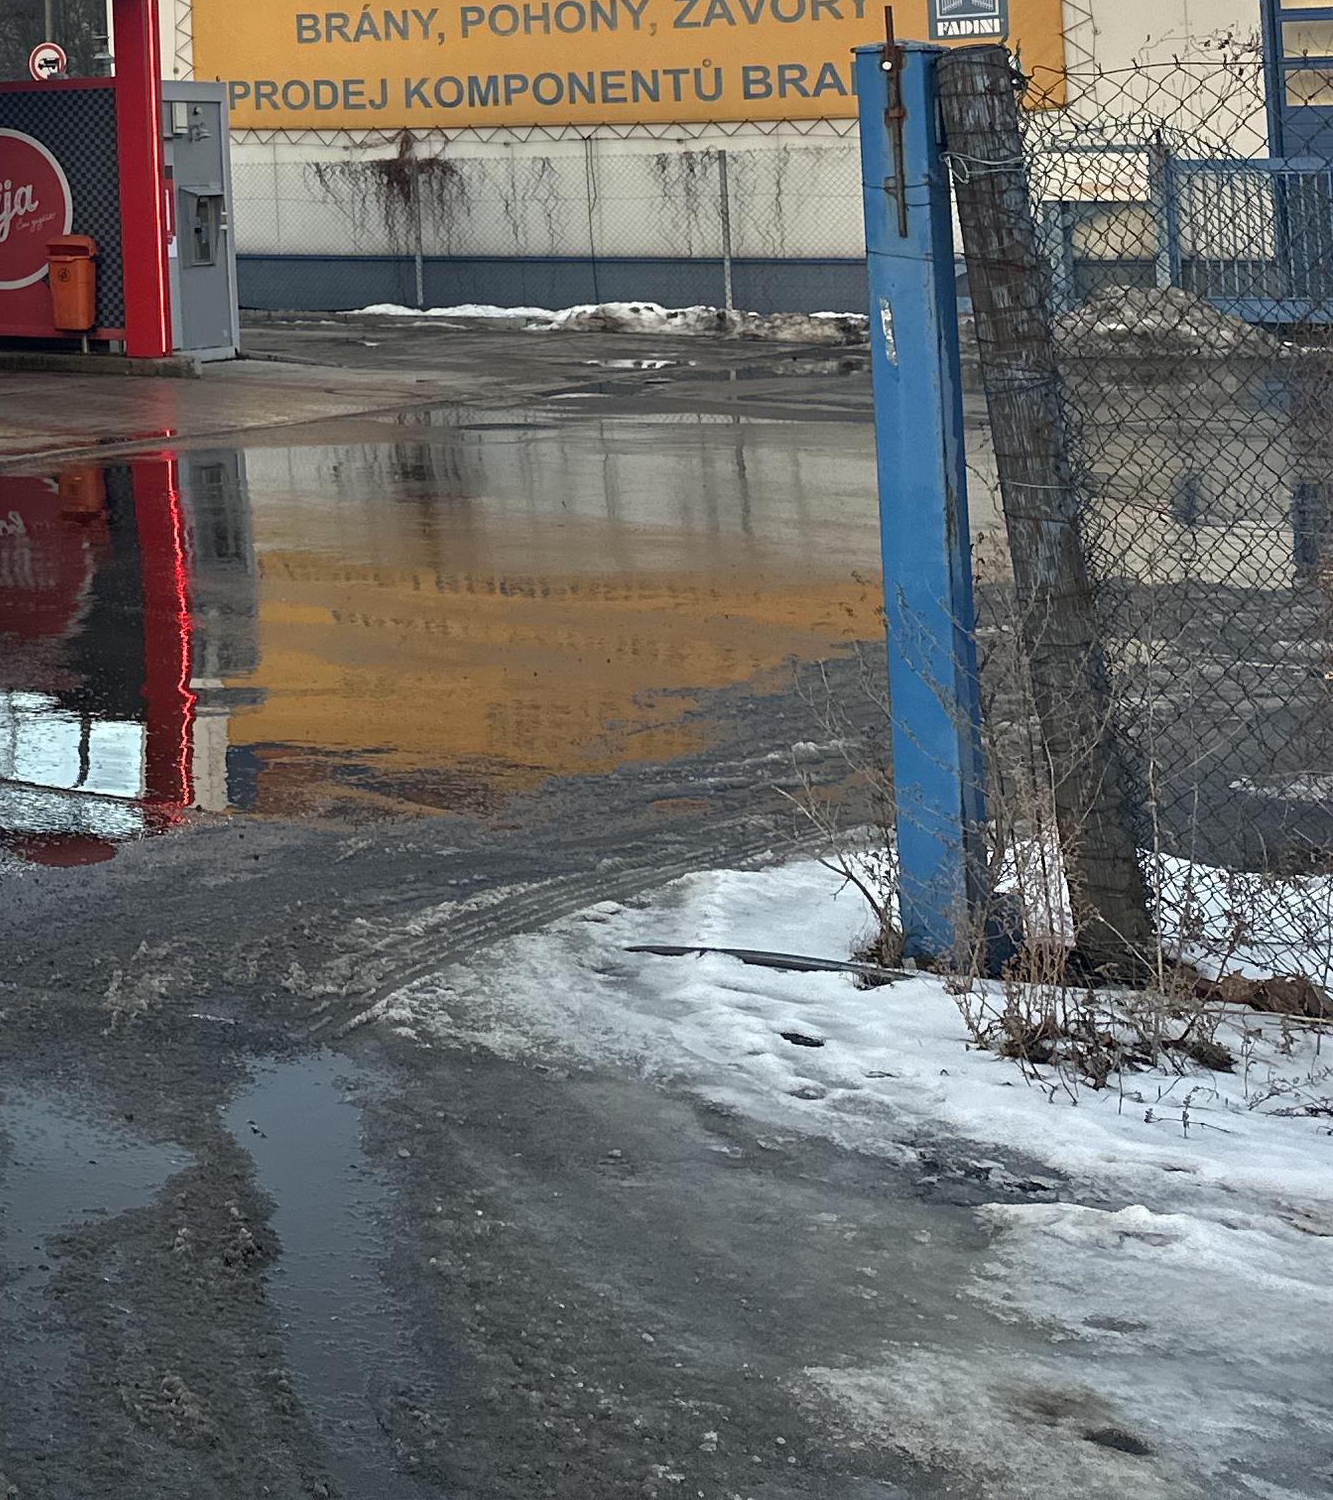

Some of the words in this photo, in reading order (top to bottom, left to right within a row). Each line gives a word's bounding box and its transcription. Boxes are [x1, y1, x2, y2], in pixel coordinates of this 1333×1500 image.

[295, 3, 446, 46] BRÁNY,
[936, 18, 1001, 37] FADINI
[228, 77, 389, 111] PRODEJ
[404, 57, 724, 109] KOMPONENTŮ
